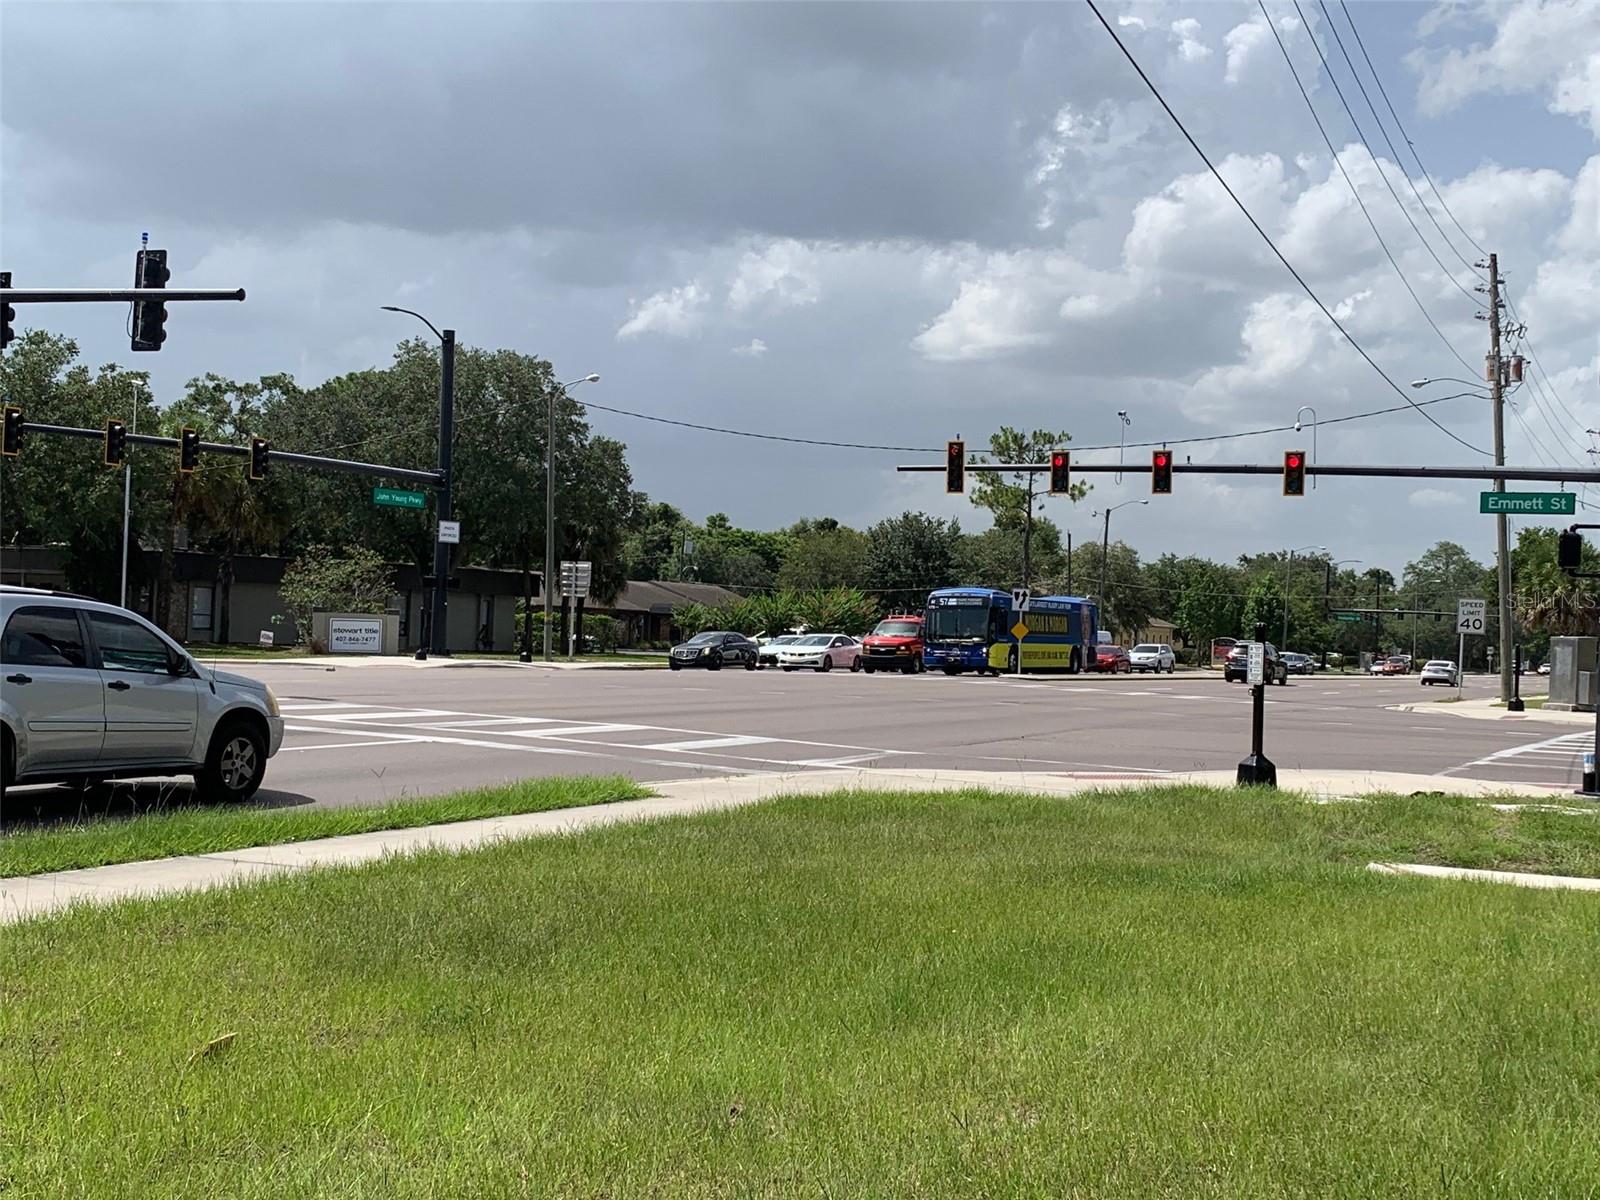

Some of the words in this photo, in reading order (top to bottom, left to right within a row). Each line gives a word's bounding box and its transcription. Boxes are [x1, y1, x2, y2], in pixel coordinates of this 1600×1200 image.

[392, 494, 408, 503] Young
[1488, 497, 1543, 509] Emmett
[1550, 497, 1567, 510] St
[1459, 618, 1483, 630] 40
